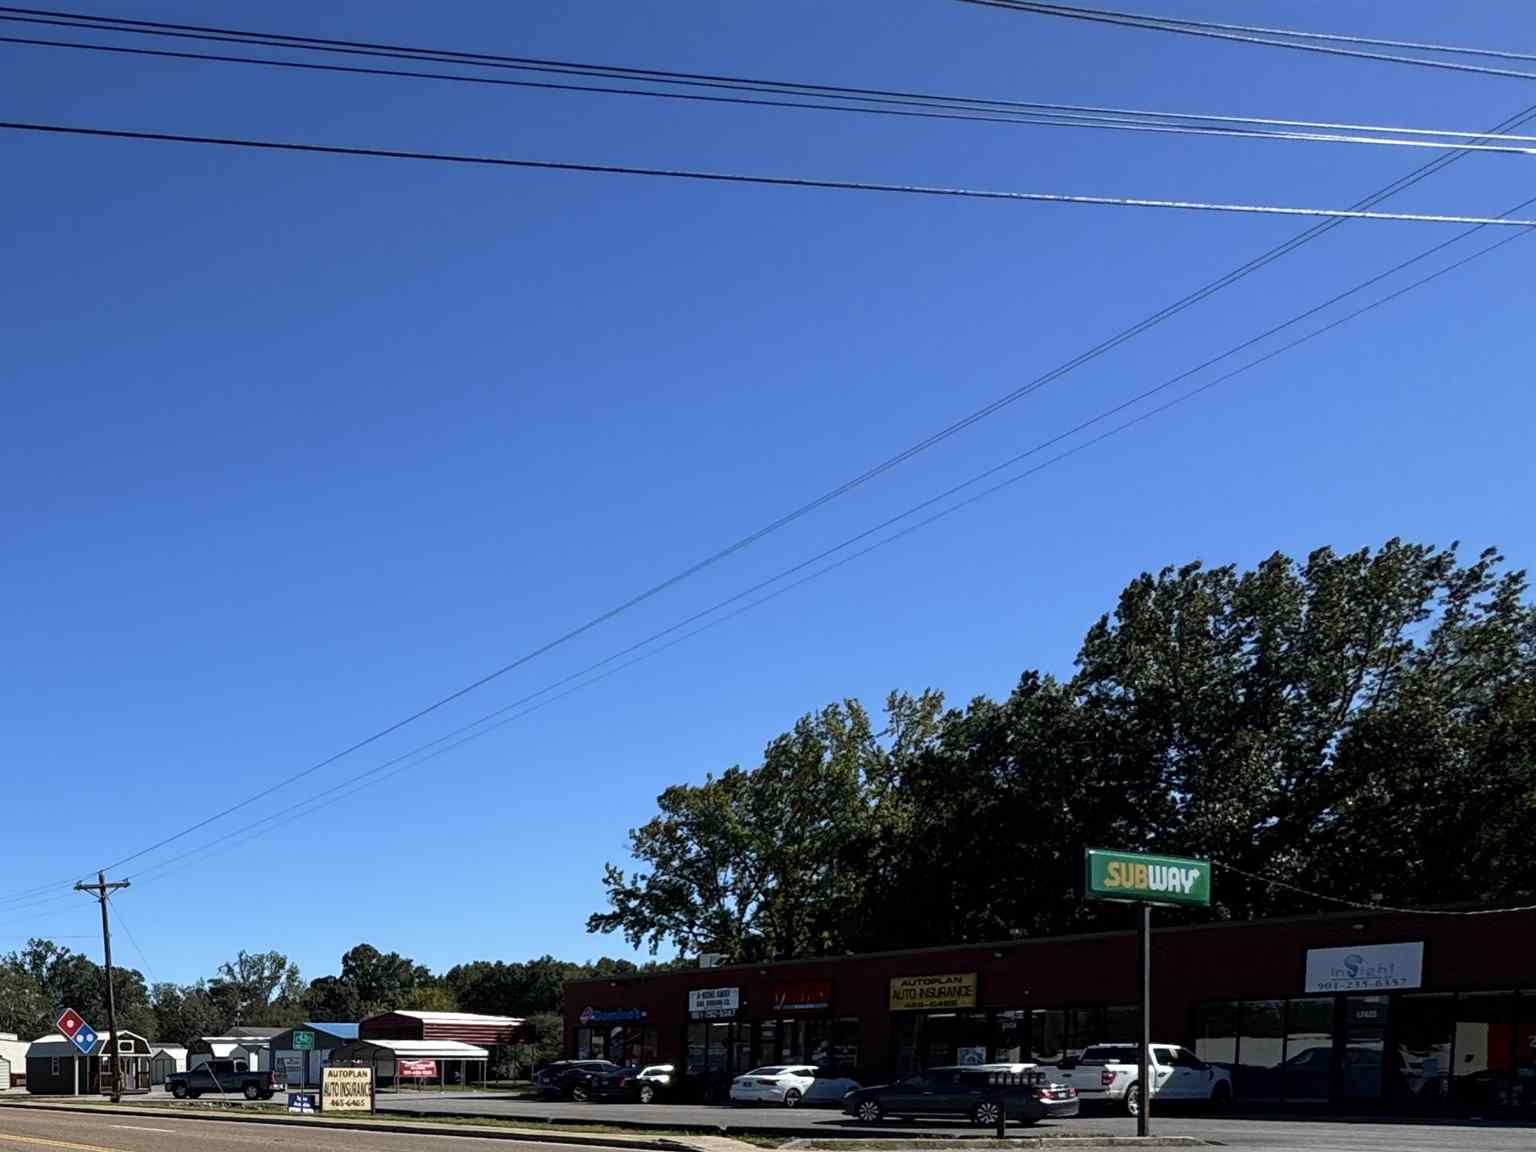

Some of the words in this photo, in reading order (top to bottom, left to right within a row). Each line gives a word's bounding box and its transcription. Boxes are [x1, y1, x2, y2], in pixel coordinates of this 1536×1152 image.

[1104, 862, 1200, 894] SUBWAY
[901, 977, 962, 986] AUTOPLAN
[893, 989, 916, 1000] AUTO
[919, 985, 972, 998] INSURANCE
[328, 1070, 368, 1078] AUTOPLAN
[324, 1082, 339, 1097] AUTO
